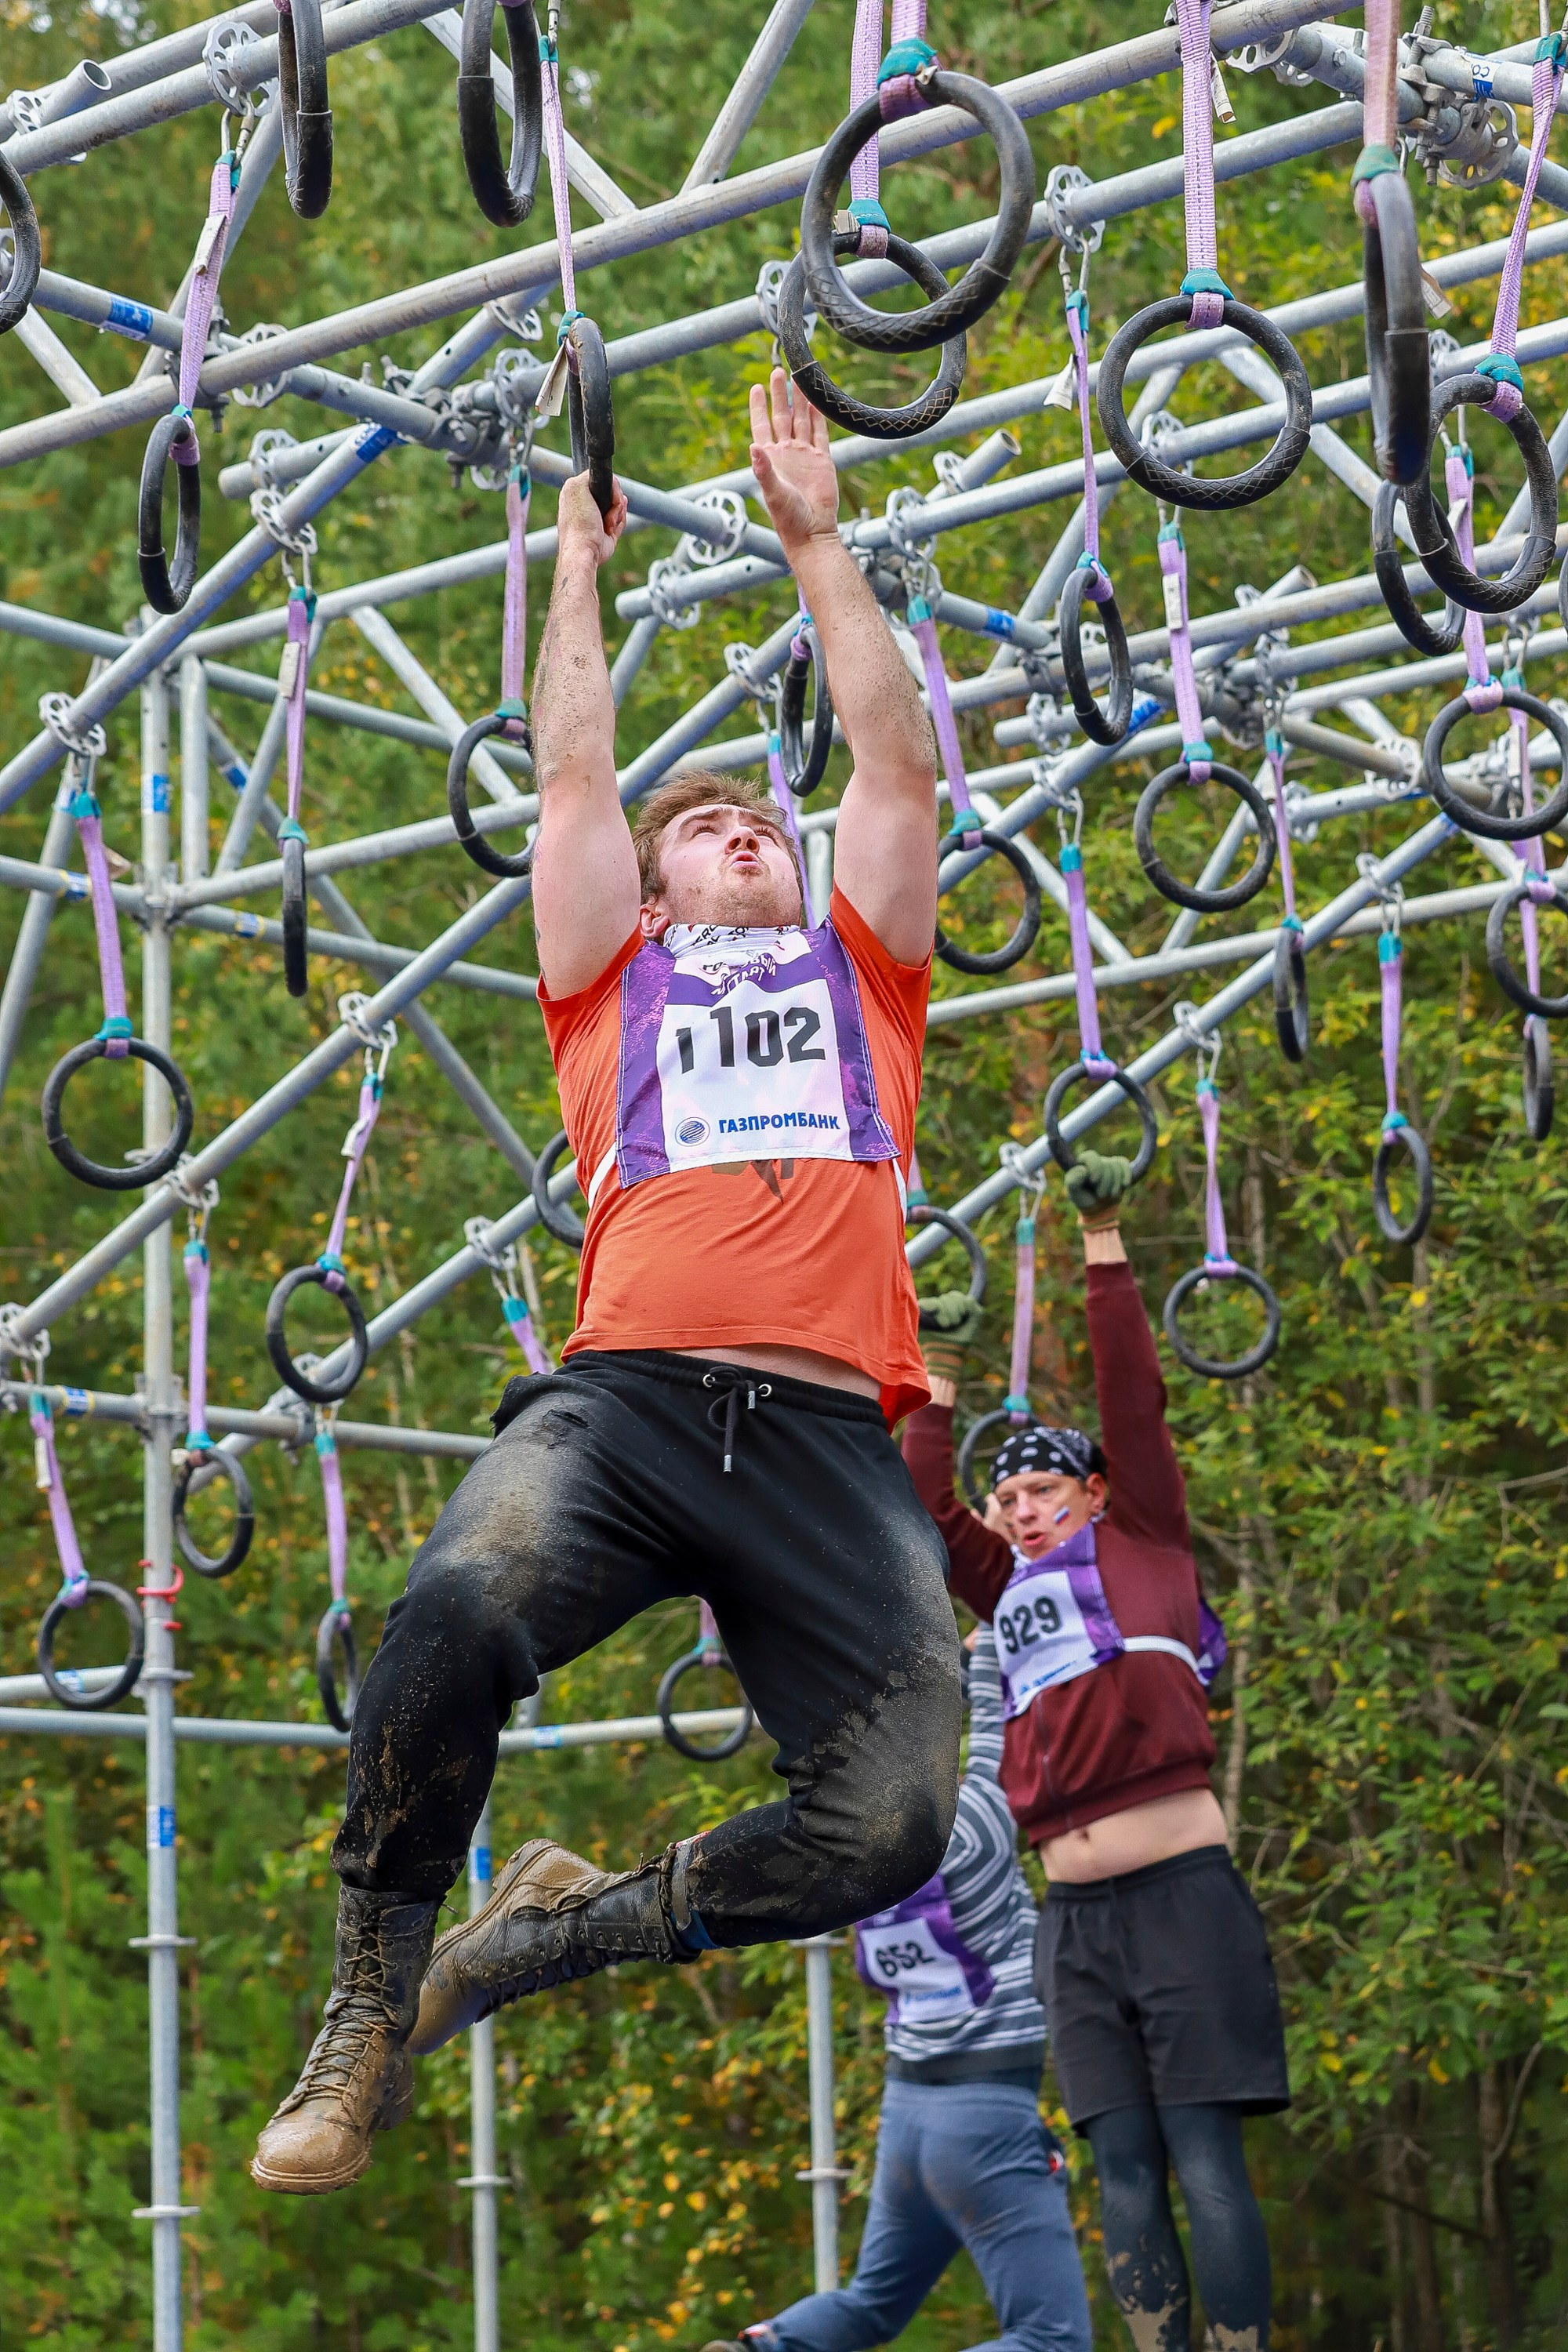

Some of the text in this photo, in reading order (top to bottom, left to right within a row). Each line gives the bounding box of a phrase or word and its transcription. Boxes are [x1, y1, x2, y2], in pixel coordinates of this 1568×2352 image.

[674, 1007, 826, 1074] 1102
[718, 1112, 840, 1134] ГАЗПРОМБАНК
[999, 1596, 1061, 1655] 929
[875, 1940, 935, 1978] 652
